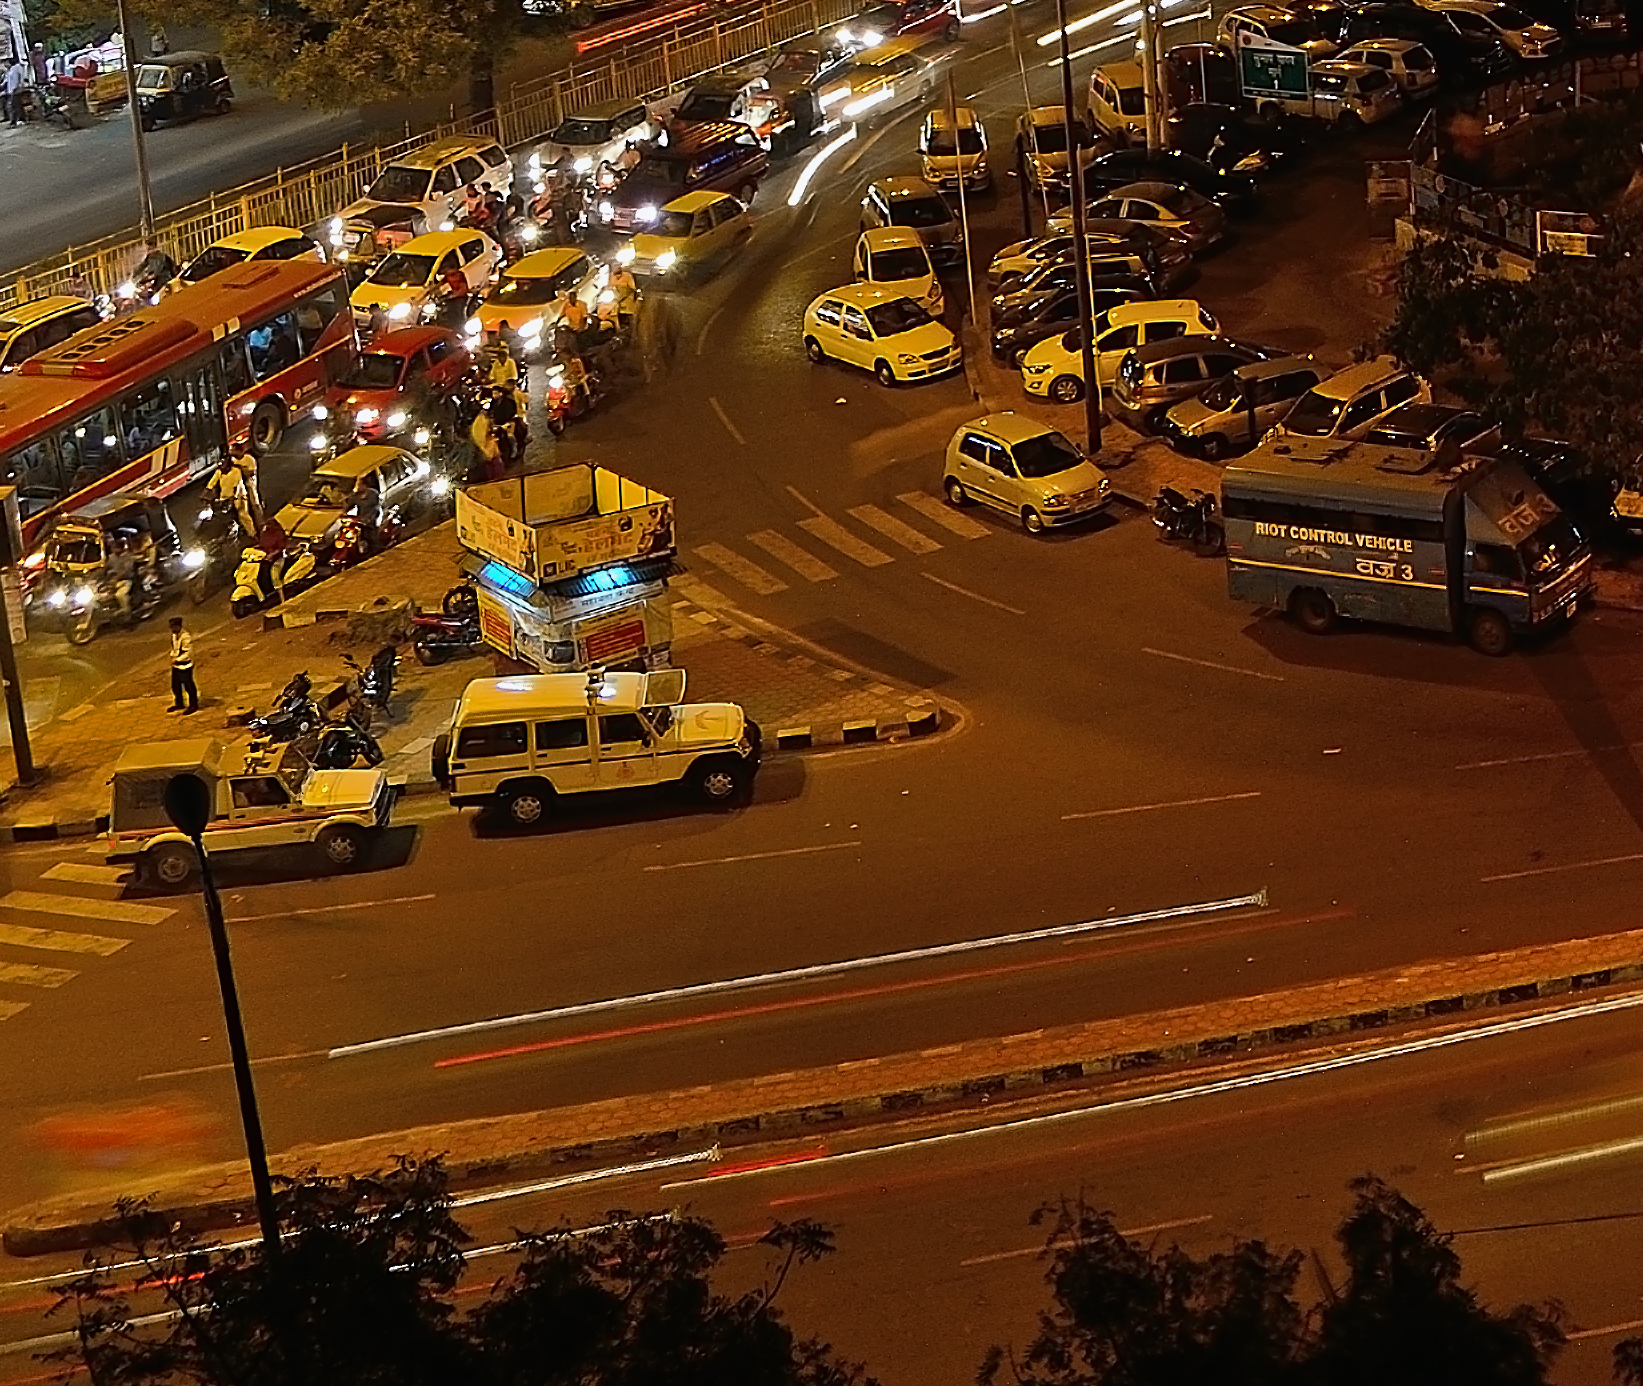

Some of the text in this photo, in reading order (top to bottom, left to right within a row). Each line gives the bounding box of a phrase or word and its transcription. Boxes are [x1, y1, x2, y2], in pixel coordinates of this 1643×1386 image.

[1255, 521, 1414, 554] RIOT CONTROL VEHICLE
[1401, 565, 1414, 581] 3
